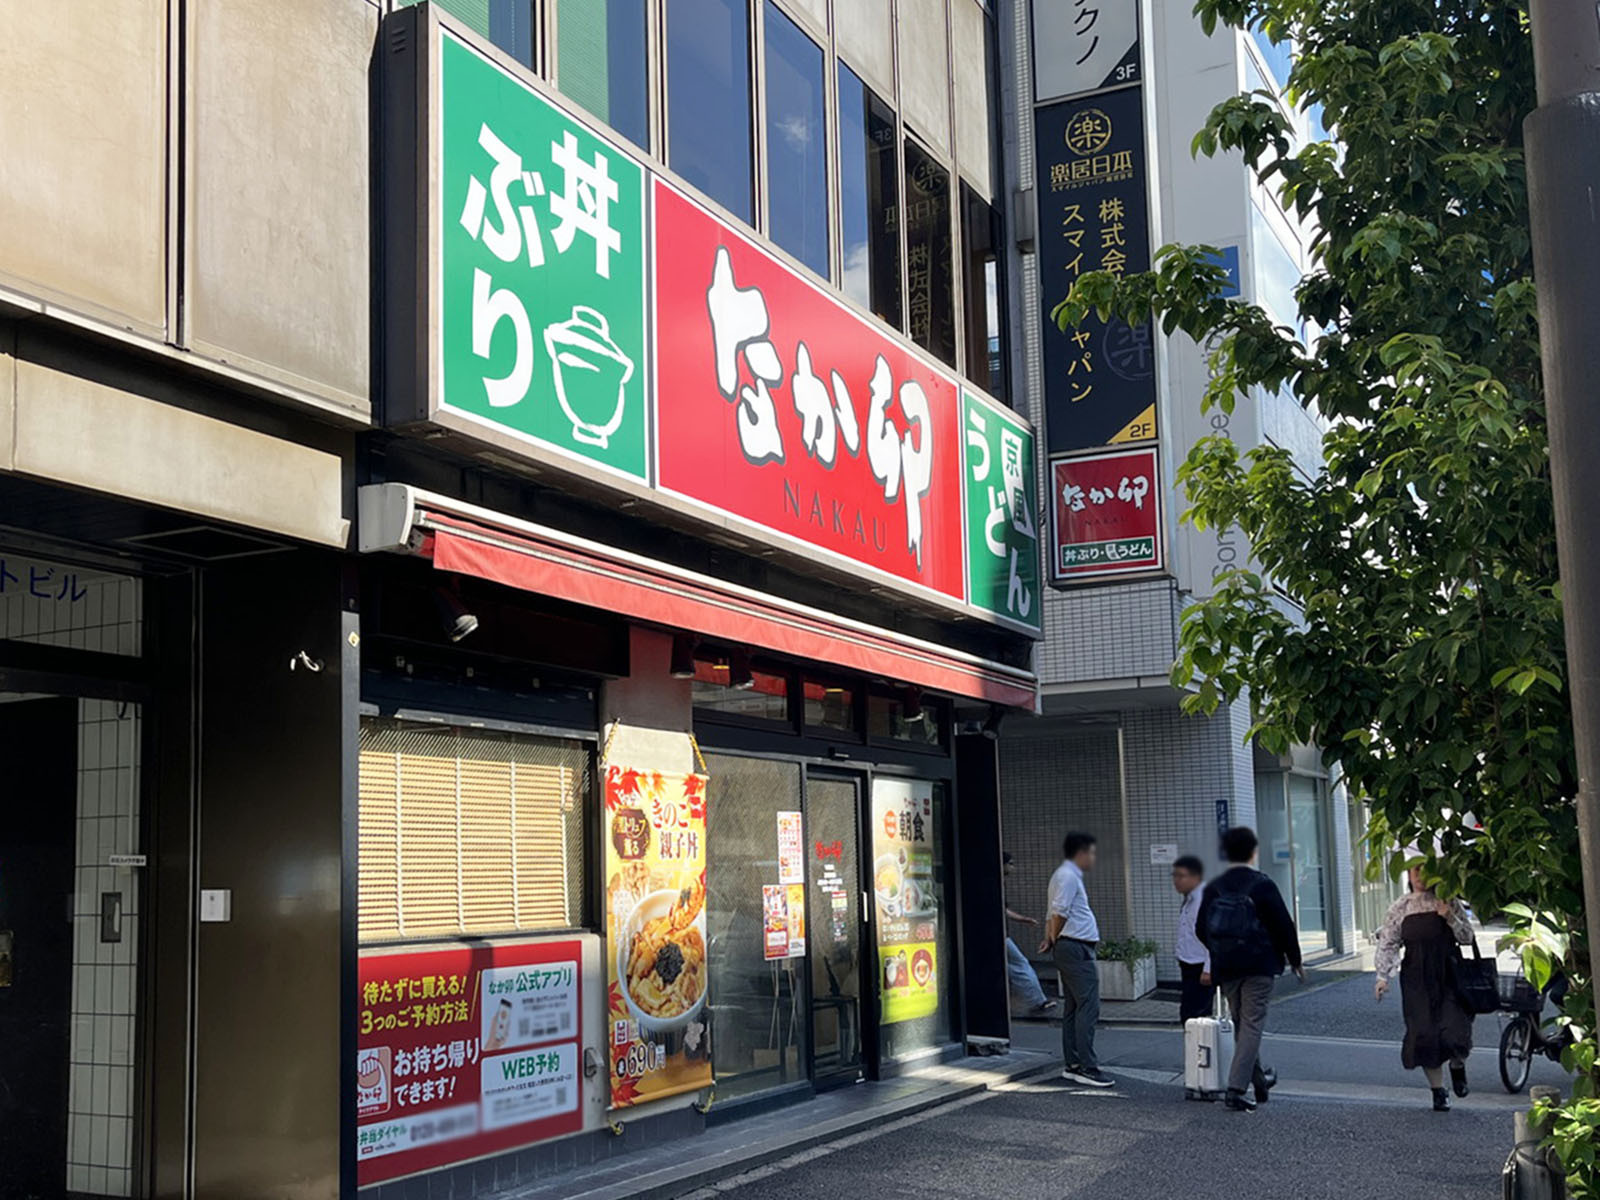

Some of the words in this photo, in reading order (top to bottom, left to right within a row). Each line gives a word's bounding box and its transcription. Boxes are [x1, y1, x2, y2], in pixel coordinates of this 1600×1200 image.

[1073, 0, 1099, 65] クノ
[1116, 64, 1136, 80] 3F
[1071, 117, 1107, 148] 楽
[1050, 150, 1133, 183] 楽居日本
[551, 129, 621, 279] 丼
[460, 122, 546, 408] ぶり
[1062, 204, 1092, 402] スマイャパン
[707, 244, 933, 573] なか卯
[1130, 423, 1152, 438] 2F
[1063, 475, 1149, 512] なか卯
[784, 478, 887, 553] NAKAU
[967, 407, 1032, 618] うどん
[0, 559, 88, 602] トビル
[652, 798, 689, 829] きのこ
[899, 810, 925, 842] 朝食
[363, 975, 467, 1006] 待たずに買える!
[516, 967, 572, 993] 公式アプリ
[360, 999, 469, 1035] 3つのご予約方法
[393, 1037, 480, 1077] お持ち帰り
[502, 1051, 561, 1080] WEB予約
[393, 1075, 456, 1107] できます!
[358, 1124, 407, 1146] 弁当ダイヤル
